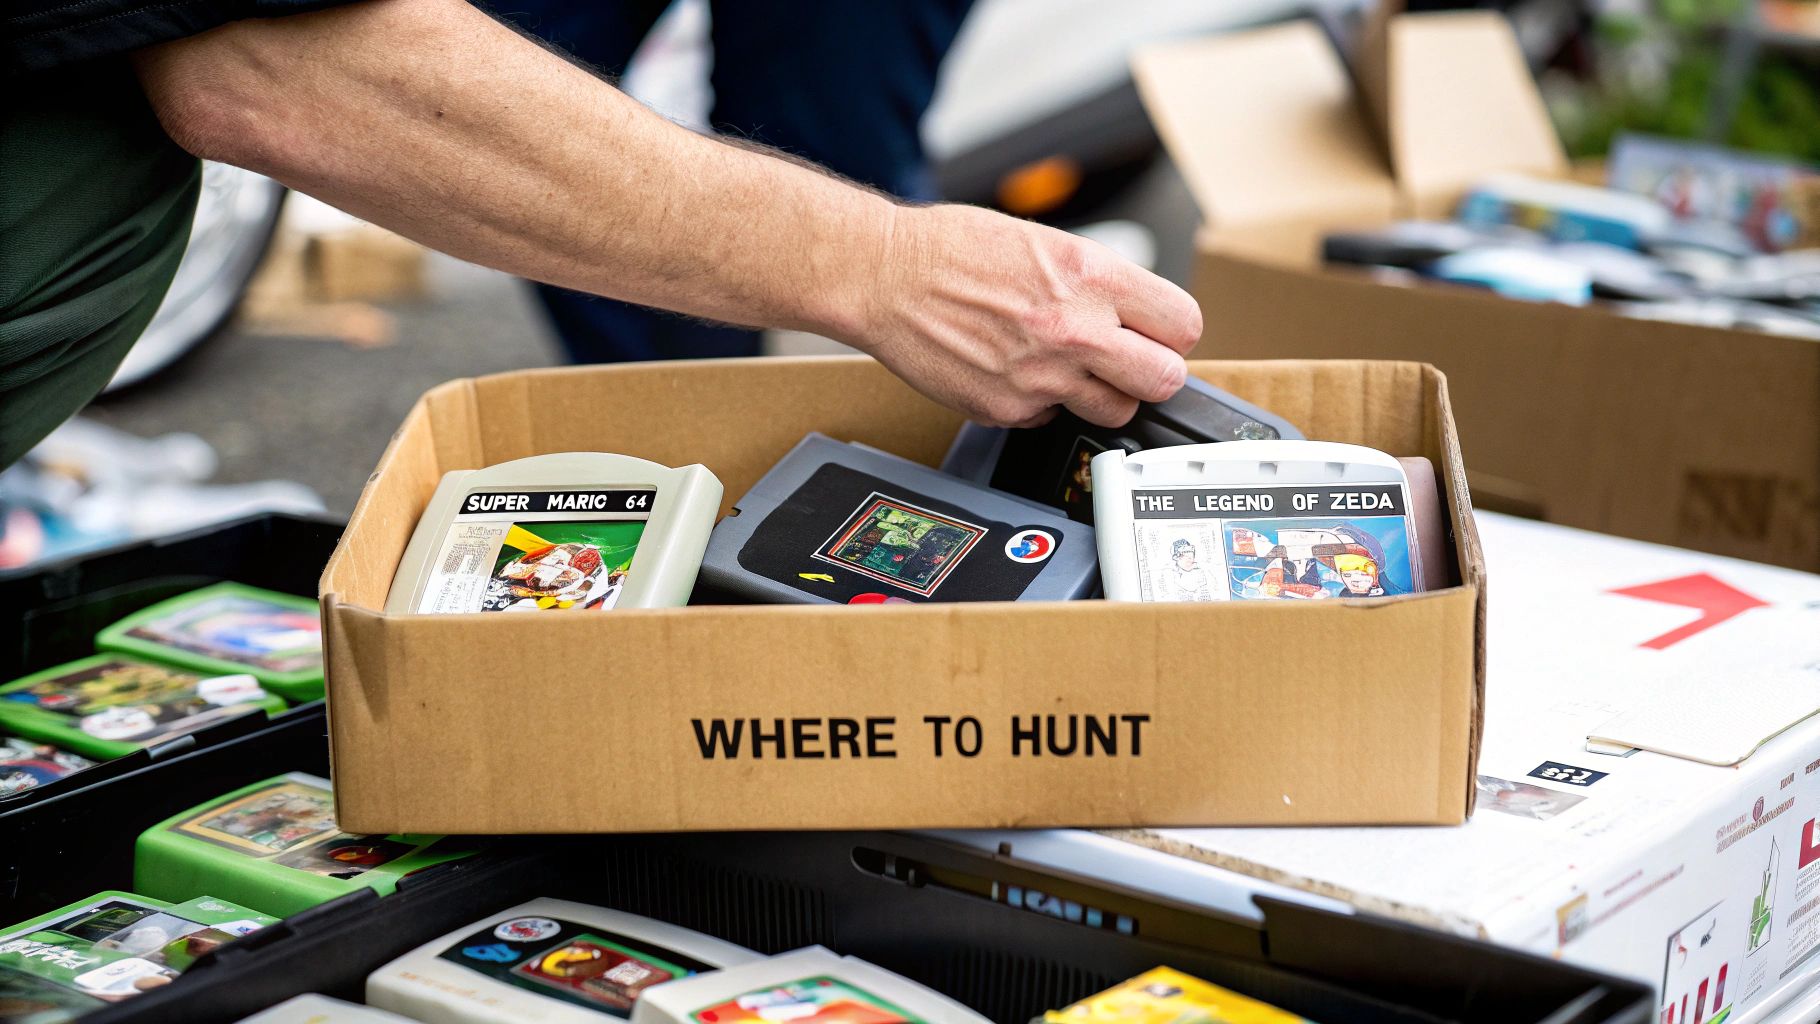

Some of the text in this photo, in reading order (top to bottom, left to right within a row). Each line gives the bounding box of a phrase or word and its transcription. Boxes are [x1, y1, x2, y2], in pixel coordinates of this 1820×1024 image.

[467, 494, 648, 512] SUPER MARIC 64
[1135, 492, 1395, 512] THE LEGEND OF ZEDA
[691, 714, 1150, 760] WHERE TO HUNT
